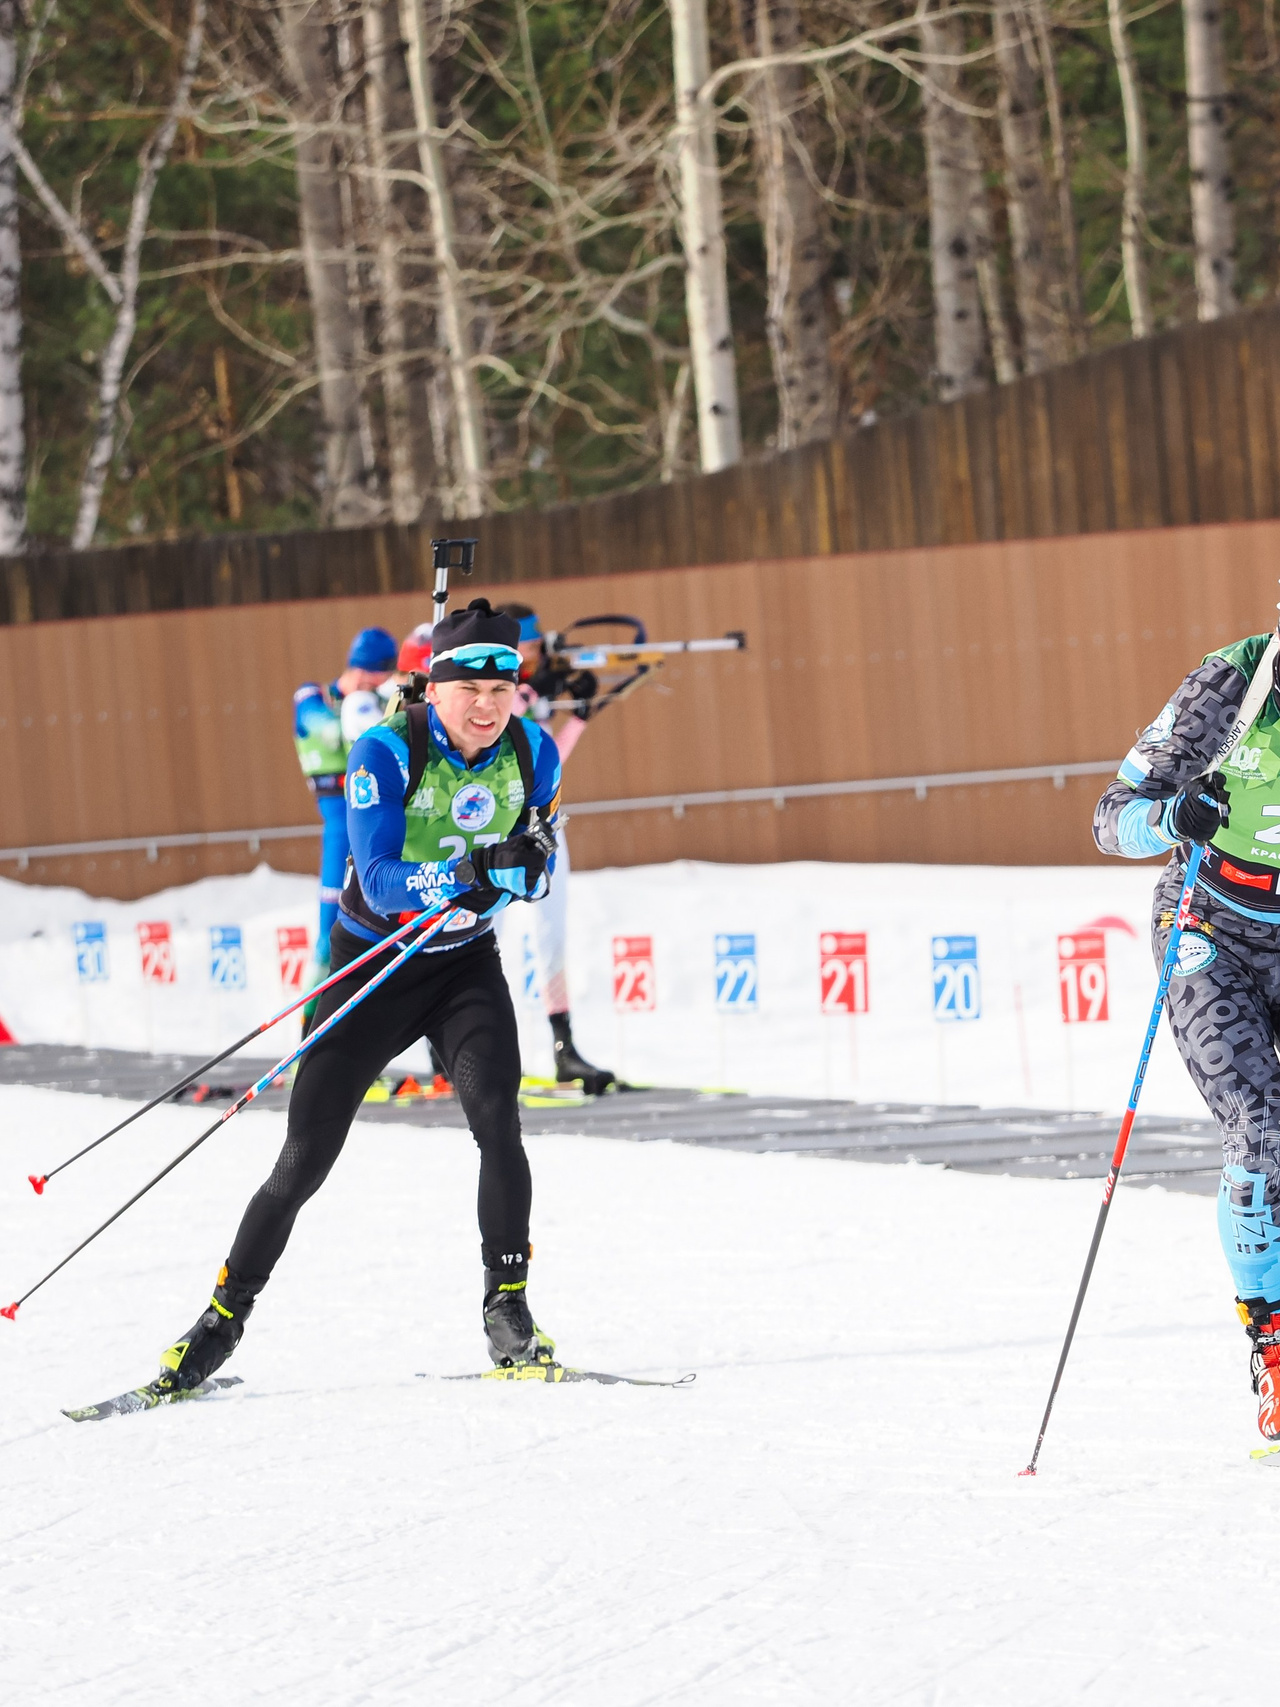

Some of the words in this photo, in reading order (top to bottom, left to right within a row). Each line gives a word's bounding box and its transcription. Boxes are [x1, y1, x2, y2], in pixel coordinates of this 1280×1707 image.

[1217, 719, 1247, 757] LARSEN
[77, 941, 109, 982] 30
[141, 941, 176, 984] 29
[211, 946, 245, 989] 28
[279, 947, 310, 991] 27
[613, 959, 655, 1012] 23
[715, 960, 757, 1011] 22
[821, 960, 868, 1013] 21
[933, 964, 979, 1019] 20
[1061, 961, 1107, 1022] 19
